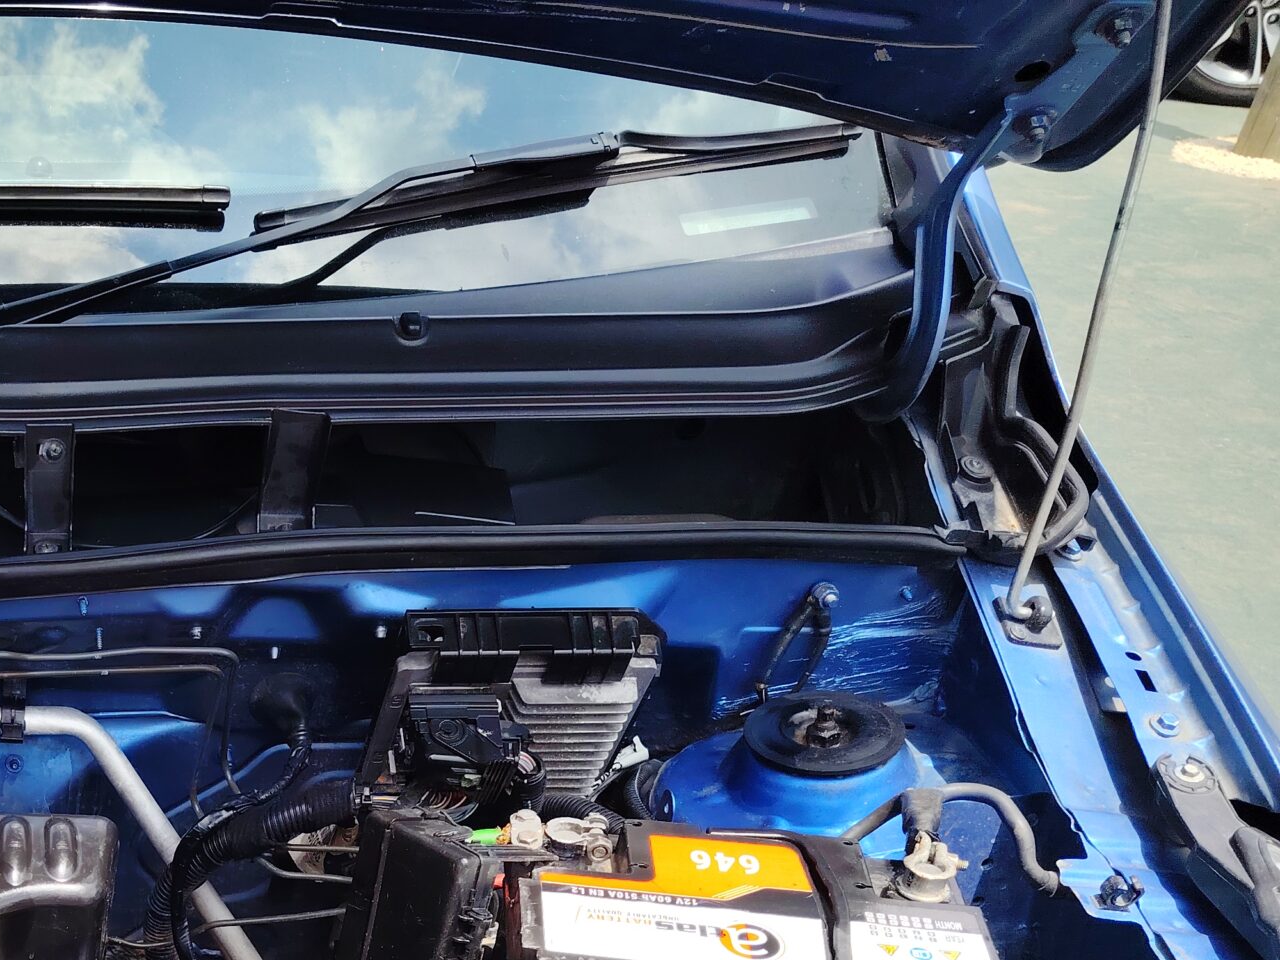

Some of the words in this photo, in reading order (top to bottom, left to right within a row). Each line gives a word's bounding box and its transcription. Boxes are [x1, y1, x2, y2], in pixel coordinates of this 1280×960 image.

[689, 849, 760, 875] 646
[571, 886, 585, 895] L2
[588, 888, 605, 896] EN
[608, 890, 638, 900] 510A
[642, 893, 672, 903] 60Ah
[675, 897, 698, 906] 12V
[587, 911, 652, 925] BATTERY
[934, 919, 963, 930] MONTH
